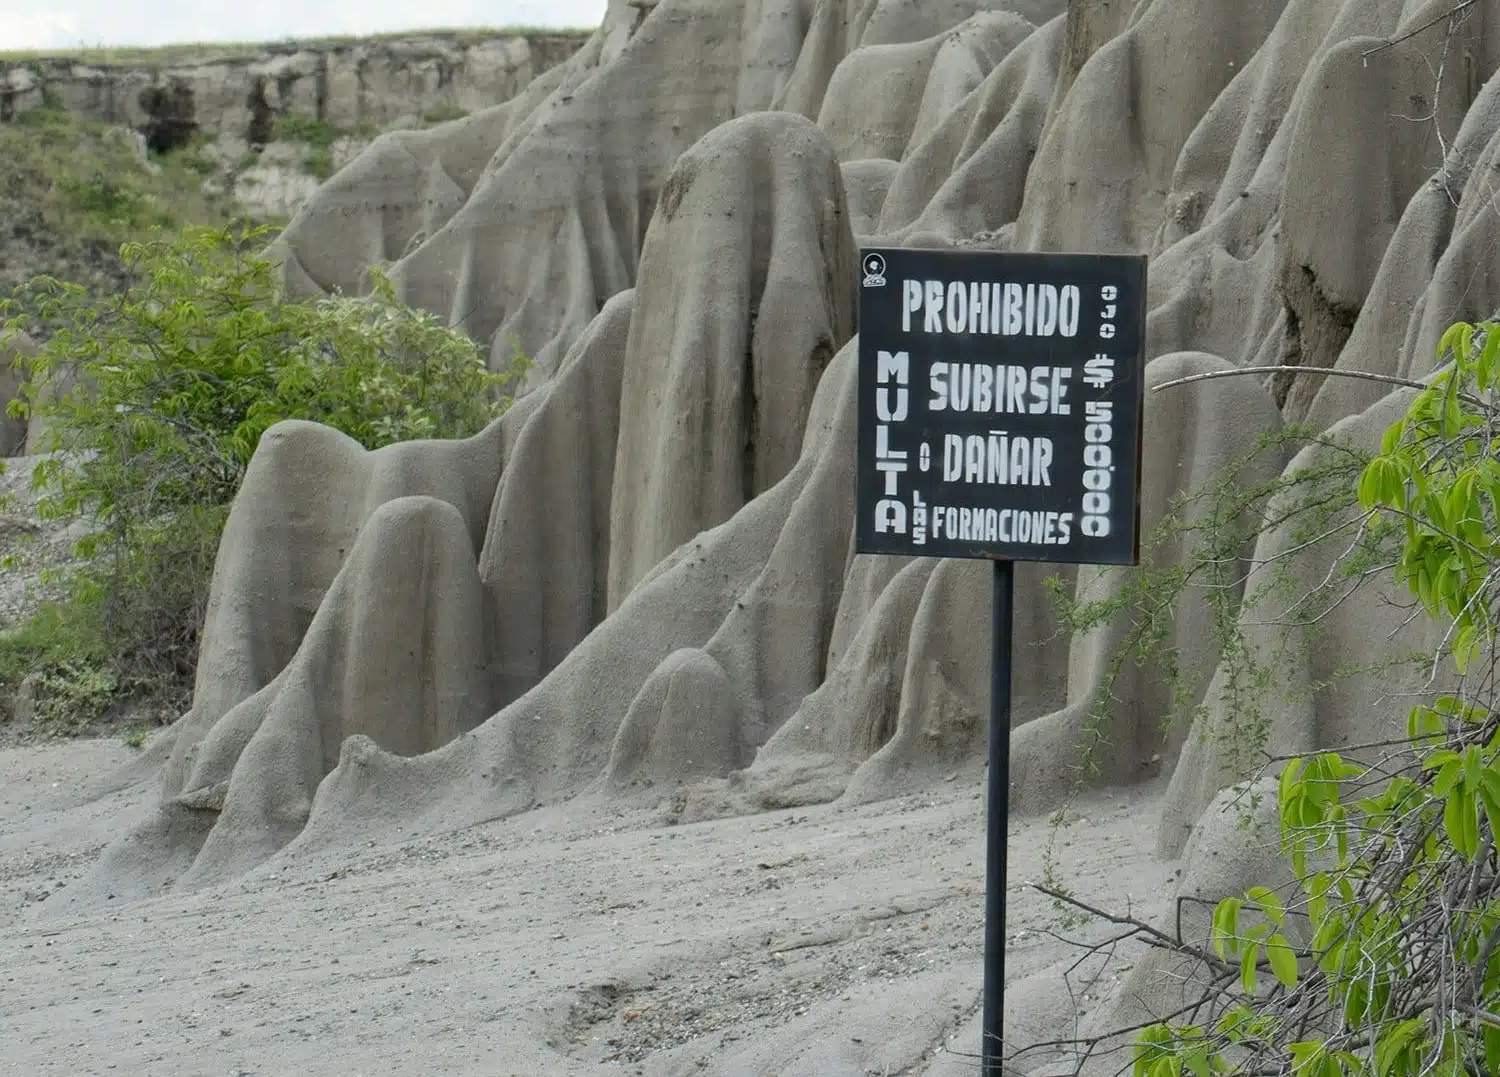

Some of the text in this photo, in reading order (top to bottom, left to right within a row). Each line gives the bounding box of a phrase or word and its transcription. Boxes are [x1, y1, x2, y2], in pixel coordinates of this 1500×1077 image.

[902, 279, 1080, 337] PROHIBIDO
[1100, 285, 1118, 339] OJO
[928, 362, 1072, 415] SUBIRSE
[874, 350, 909, 534] MULTA
[919, 430, 1054, 486] O DAÑAR
[913, 490, 927, 544] LAS
[932, 506, 1074, 545] FORMACIONES
